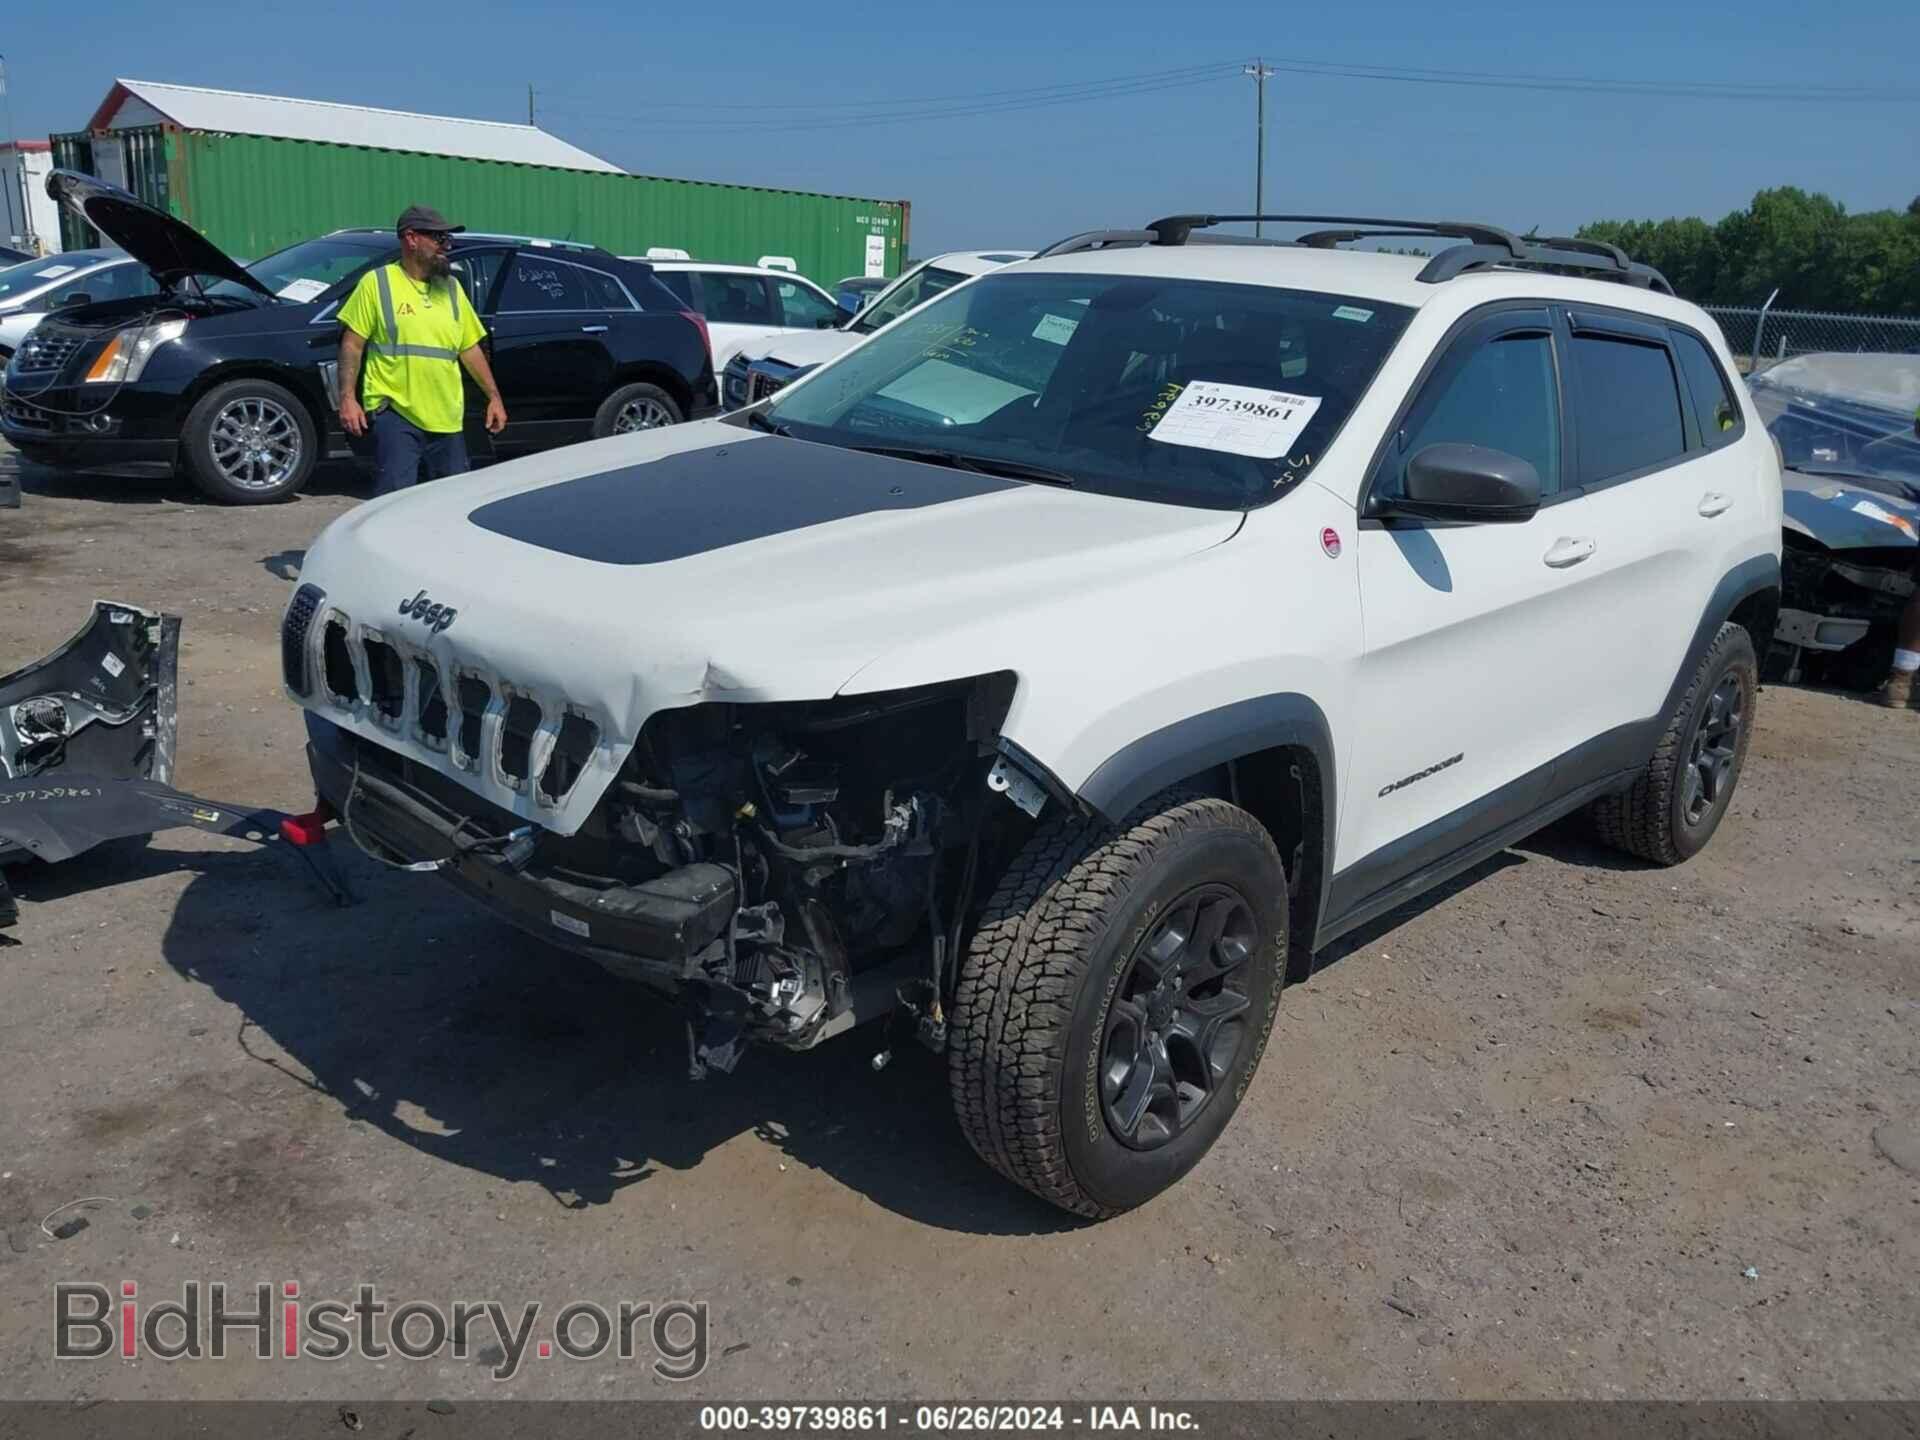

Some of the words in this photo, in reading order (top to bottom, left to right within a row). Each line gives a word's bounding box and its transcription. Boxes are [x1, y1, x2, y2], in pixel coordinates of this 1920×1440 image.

[1188, 394, 1293, 421] 39739861
[398, 589, 458, 634] Jeep
[1378, 751, 1464, 798] CHEROKEE
